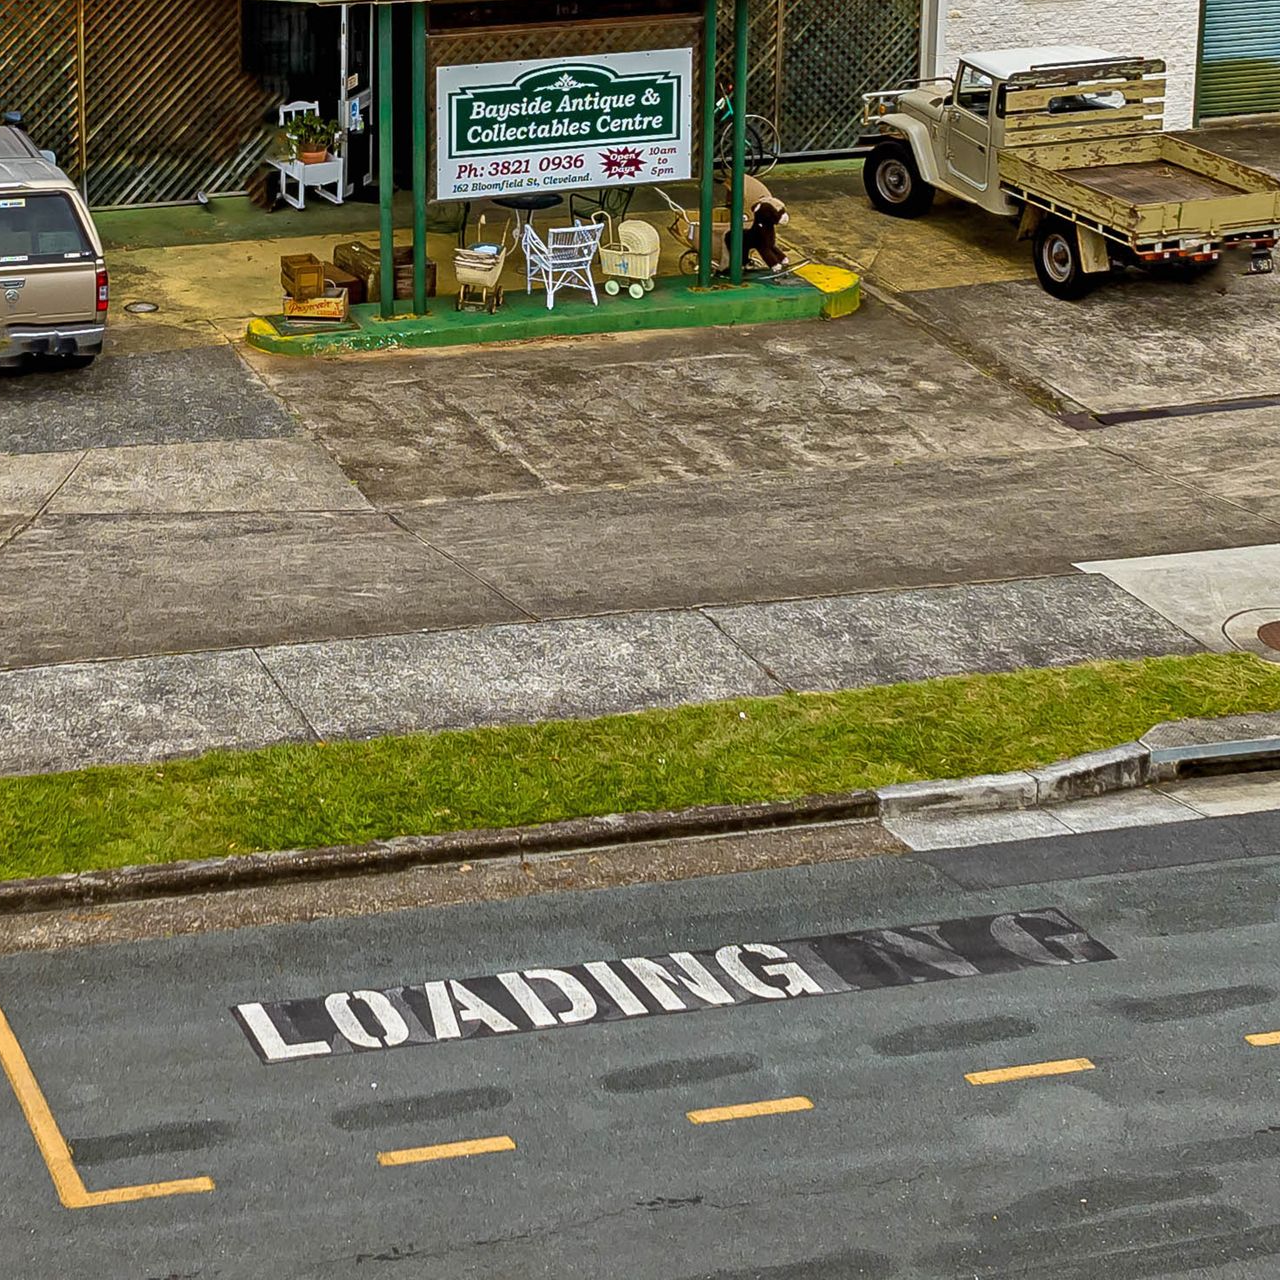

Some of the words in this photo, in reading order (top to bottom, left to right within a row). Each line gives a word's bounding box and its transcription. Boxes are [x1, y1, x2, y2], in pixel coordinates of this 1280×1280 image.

[469, 97, 552, 122] Bayside
[556, 91, 636, 115] Antique
[640, 88, 661, 106] &
[467, 117, 591, 144] Collectables
[596, 113, 663, 134] Centre
[609, 153, 637, 162] Open
[648, 147, 677, 156] 10am
[455, 163, 485, 180] Ph:
[488, 158, 531, 176] 3821
[538, 154, 585, 171] 0936
[620, 160, 627, 168] 7
[650, 166, 674, 176] 5pm
[452, 183, 469, 193] 162
[471, 177, 524, 192] Bloomfield
[526, 177, 540, 188] St,
[543, 172, 593, 186] Cleveland.
[237, 942, 824, 1062] LOADING
